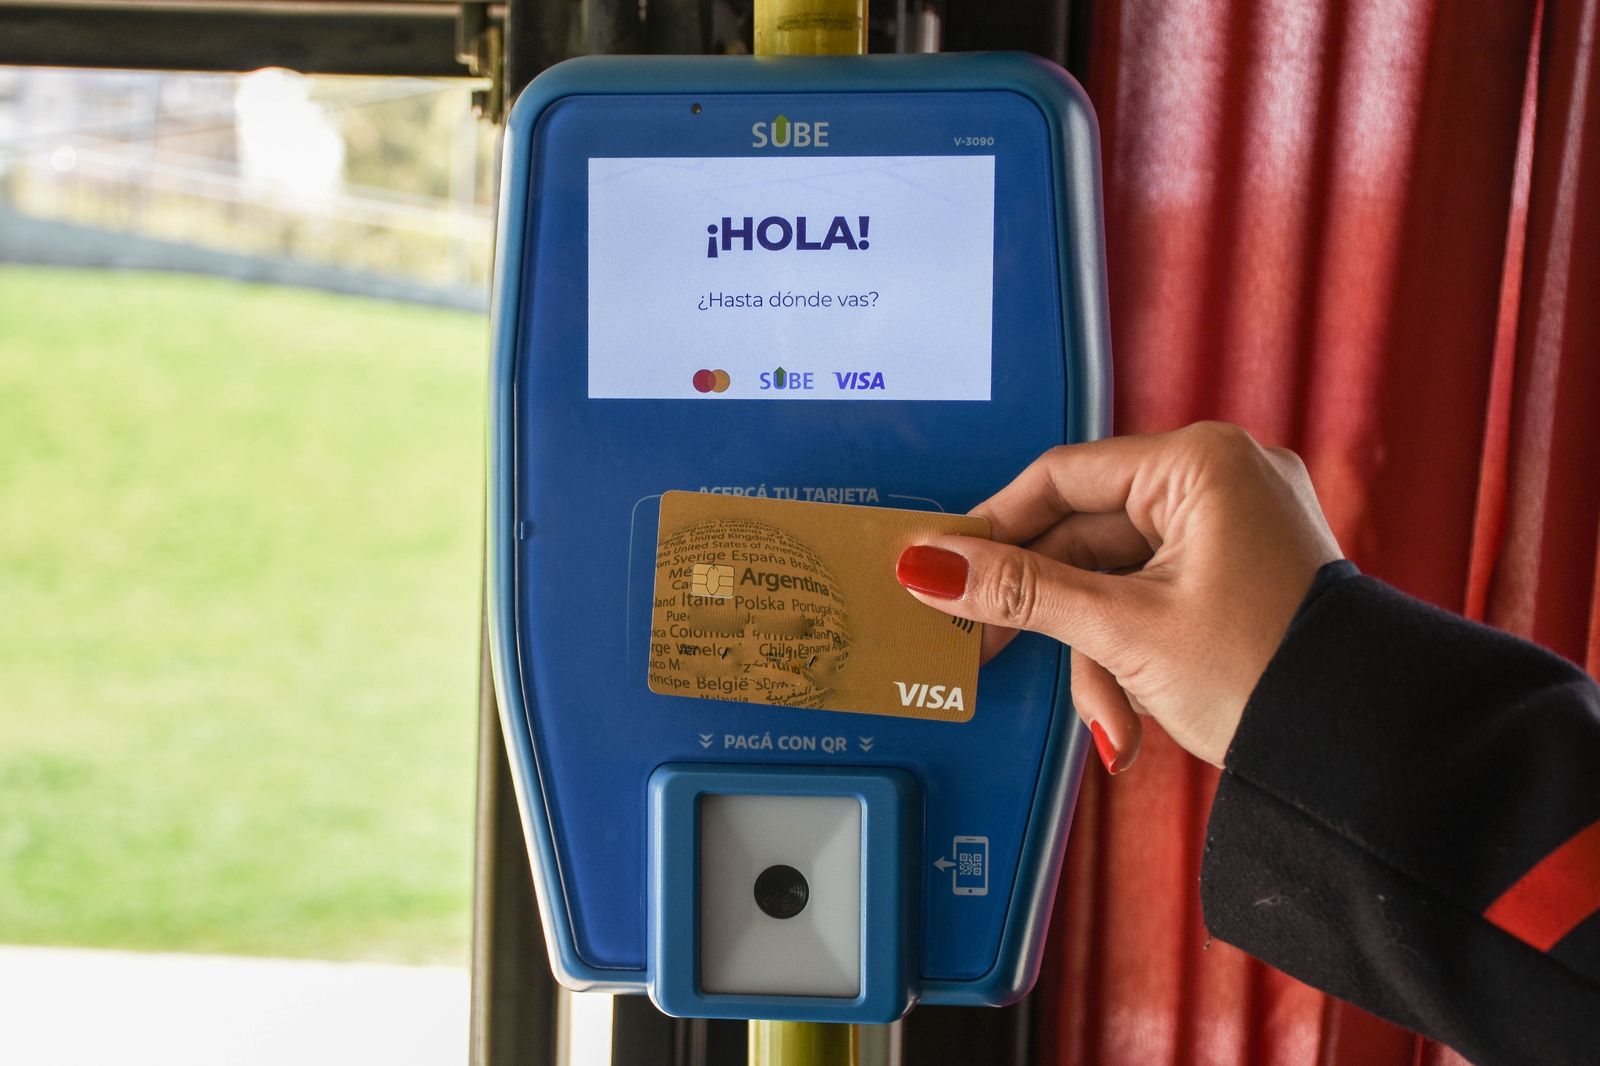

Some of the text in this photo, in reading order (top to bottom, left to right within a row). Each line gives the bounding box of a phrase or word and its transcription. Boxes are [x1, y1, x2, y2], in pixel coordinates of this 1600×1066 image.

[752, 114, 829, 147] SUBE
[954, 136, 995, 146] V-3090
[707, 216, 870, 259] ¡HOLA!
[698, 291, 879, 311] ¿Hasta dónde vas?
[759, 367, 814, 390] SUBE
[832, 371, 886, 390] VISA
[773, 486, 798, 500] TU
[803, 487, 879, 504] TARJETA
[690, 532, 725, 543] United
[728, 532, 776, 544] Kingdom
[672, 550, 726, 567] Sverige
[732, 550, 786, 565] España
[673, 542, 709, 555] United
[712, 540, 747, 549] States
[750, 541, 761, 549] of
[764, 543, 804, 559] America
[740, 568, 830, 597] Argentina
[735, 596, 785, 610] Polska
[792, 599, 832, 616] Portugal
[697, 676, 749, 694] België
[894, 681, 965, 712] VISA
[724, 732, 847, 754] PAGÁ CON QR
